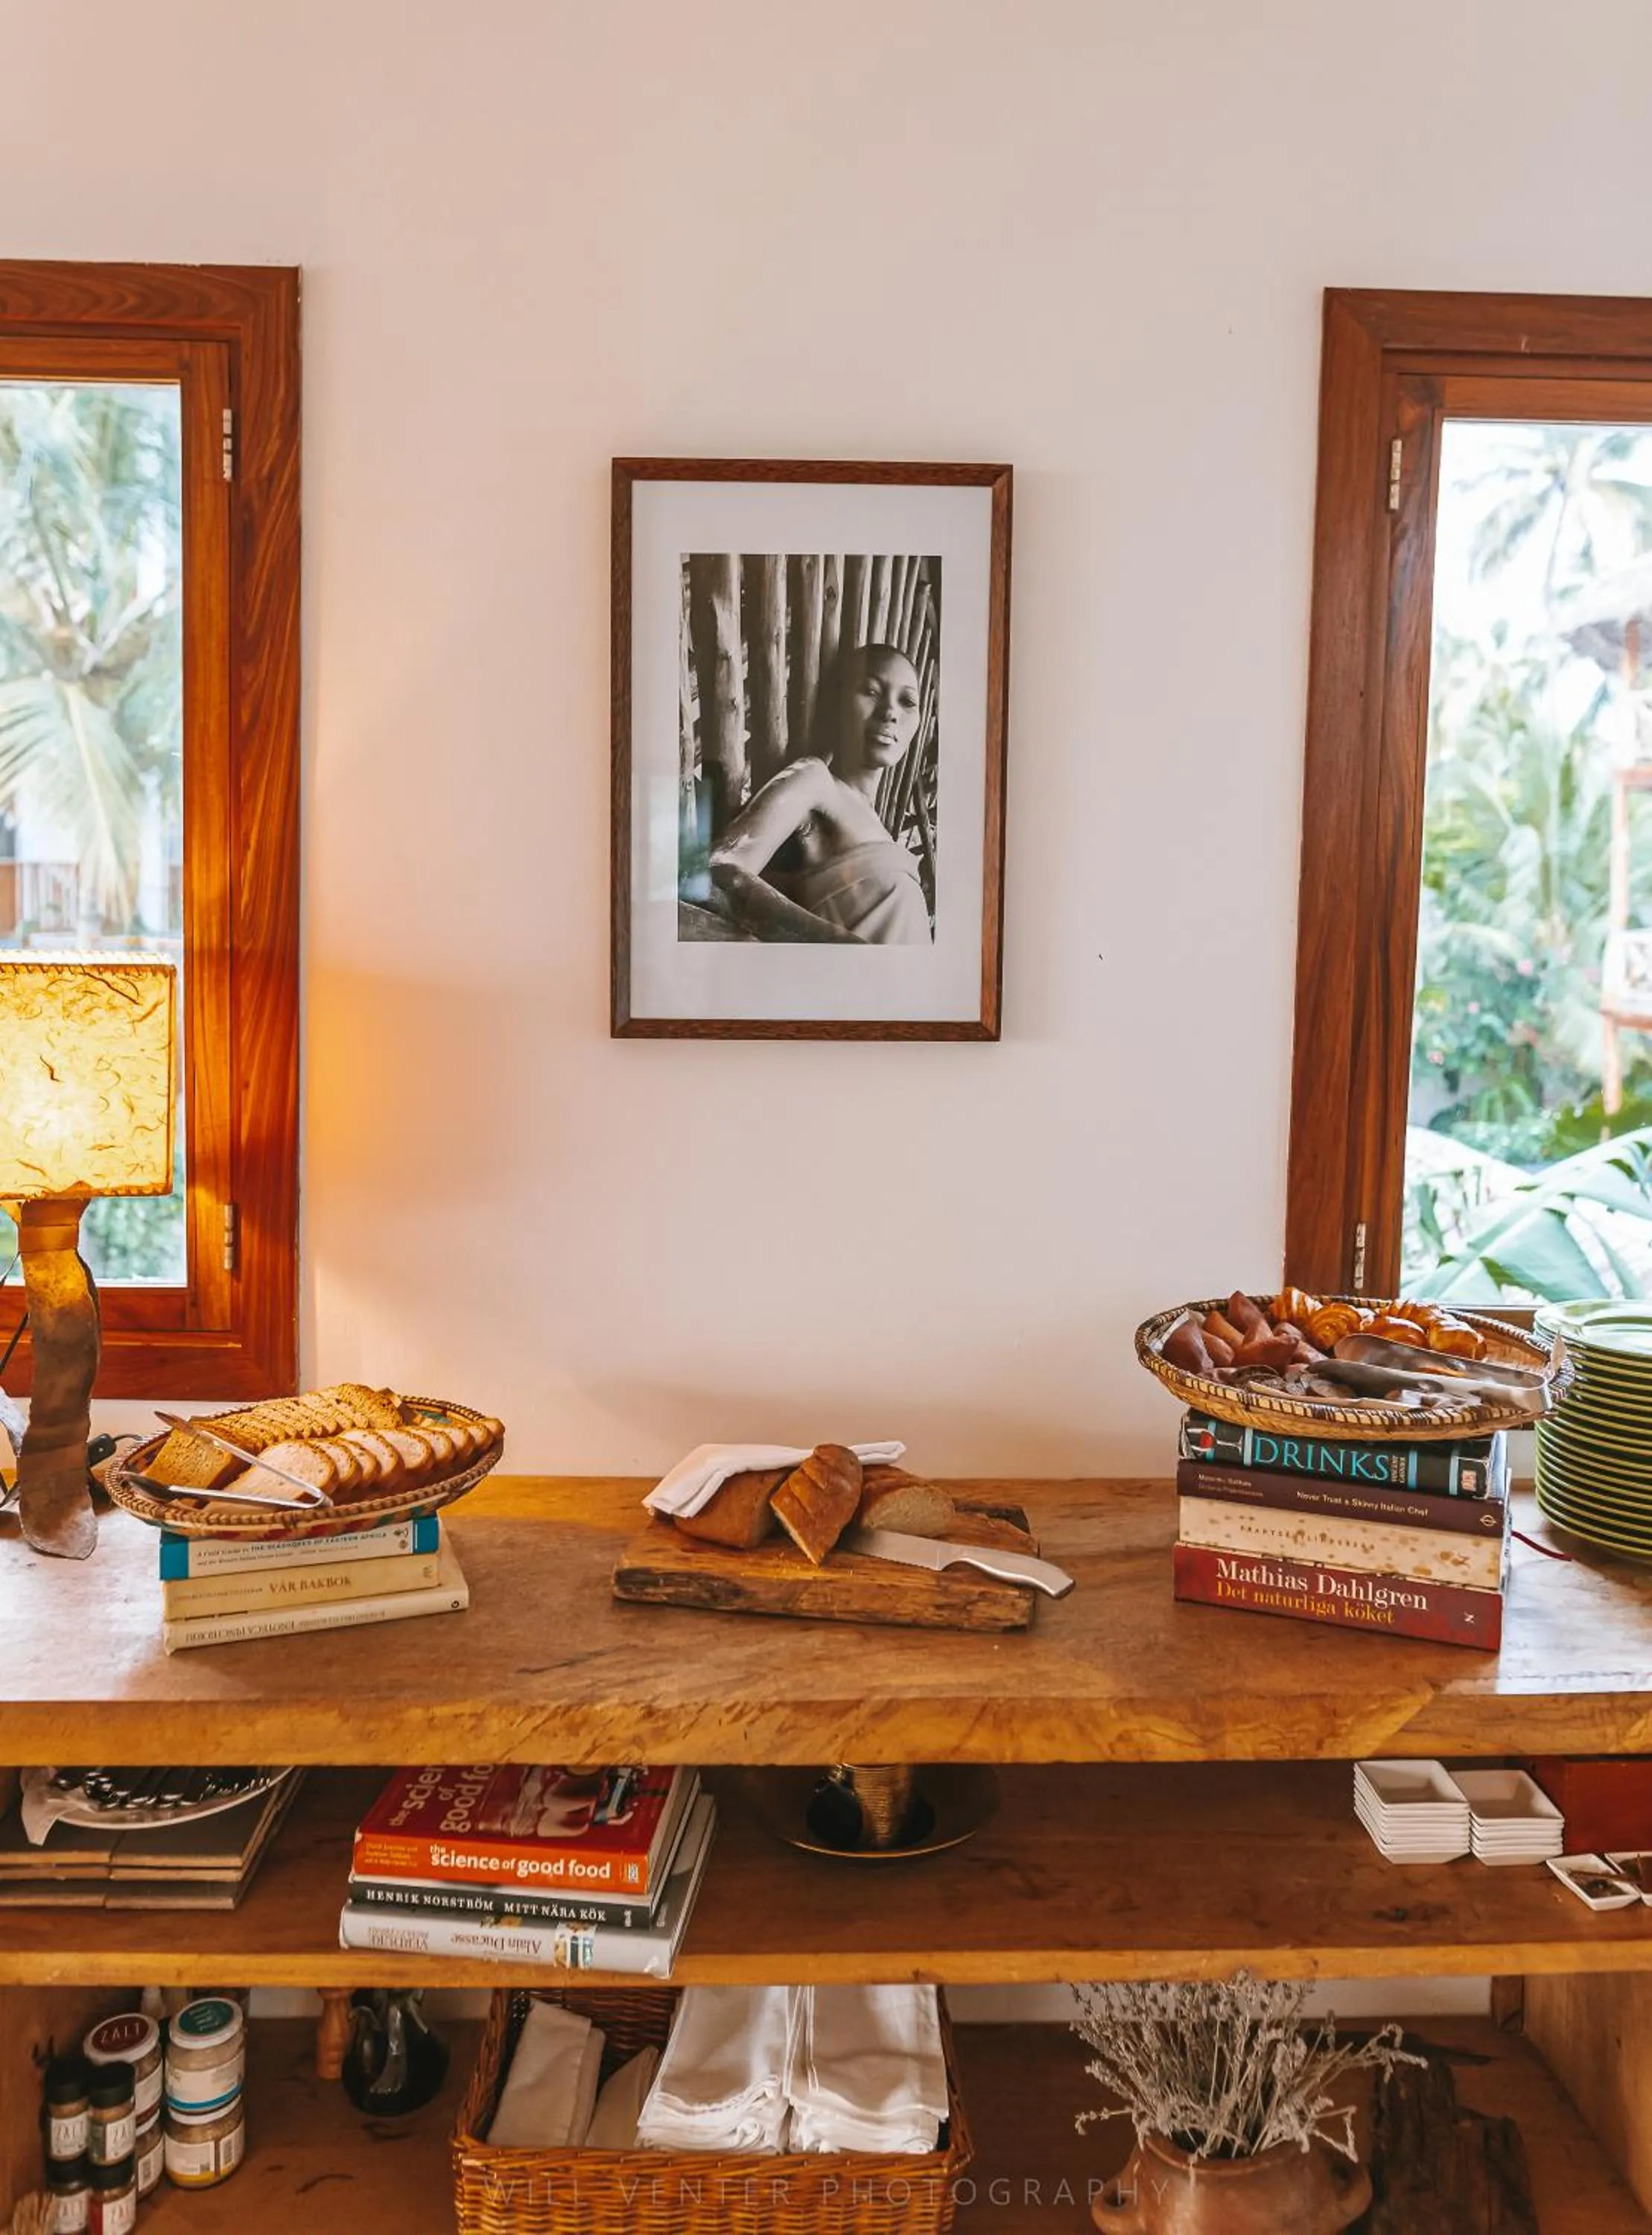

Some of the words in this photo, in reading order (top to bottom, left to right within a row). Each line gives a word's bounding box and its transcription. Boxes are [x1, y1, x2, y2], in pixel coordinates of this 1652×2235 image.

[1254, 1435, 1389, 1481] DRINKS
[1297, 1491, 1320, 1501] Never
[1322, 1494, 1341, 1504] Trust
[1352, 1498, 1379, 1511] Skinny
[1380, 1502, 1405, 1512] Italian
[1407, 1506, 1429, 1516] Chef
[270, 1577, 296, 1594] VÅR
[299, 1576, 352, 1591] BAKBOK
[1216, 1558, 1308, 1591] Mathias
[1317, 1573, 1429, 1610] Dahlgren
[1217, 1581, 1247, 1601] Det
[1254, 1590, 1337, 1616] naturliga
[1344, 1602, 1395, 1625] köket
[438, 1786, 457, 1801] of
[439, 1783, 484, 1833] good
[430, 1843, 447, 1855] the
[431, 1850, 501, 1871] science
[501, 1857, 517, 1870] of
[516, 1858, 565, 1878] good
[568, 1859, 611, 1879] food
[366, 1889, 419, 1904] HENRIK
[422, 1895, 495, 1912] NORSTRÖM
[503, 1901, 539, 1915] MITT
[541, 1902, 576, 1919] NÄRA
[579, 1908, 608, 1922] KÖK
[450, 1933, 505, 1952] Ducasse
[508, 1938, 542, 1955] Alain
